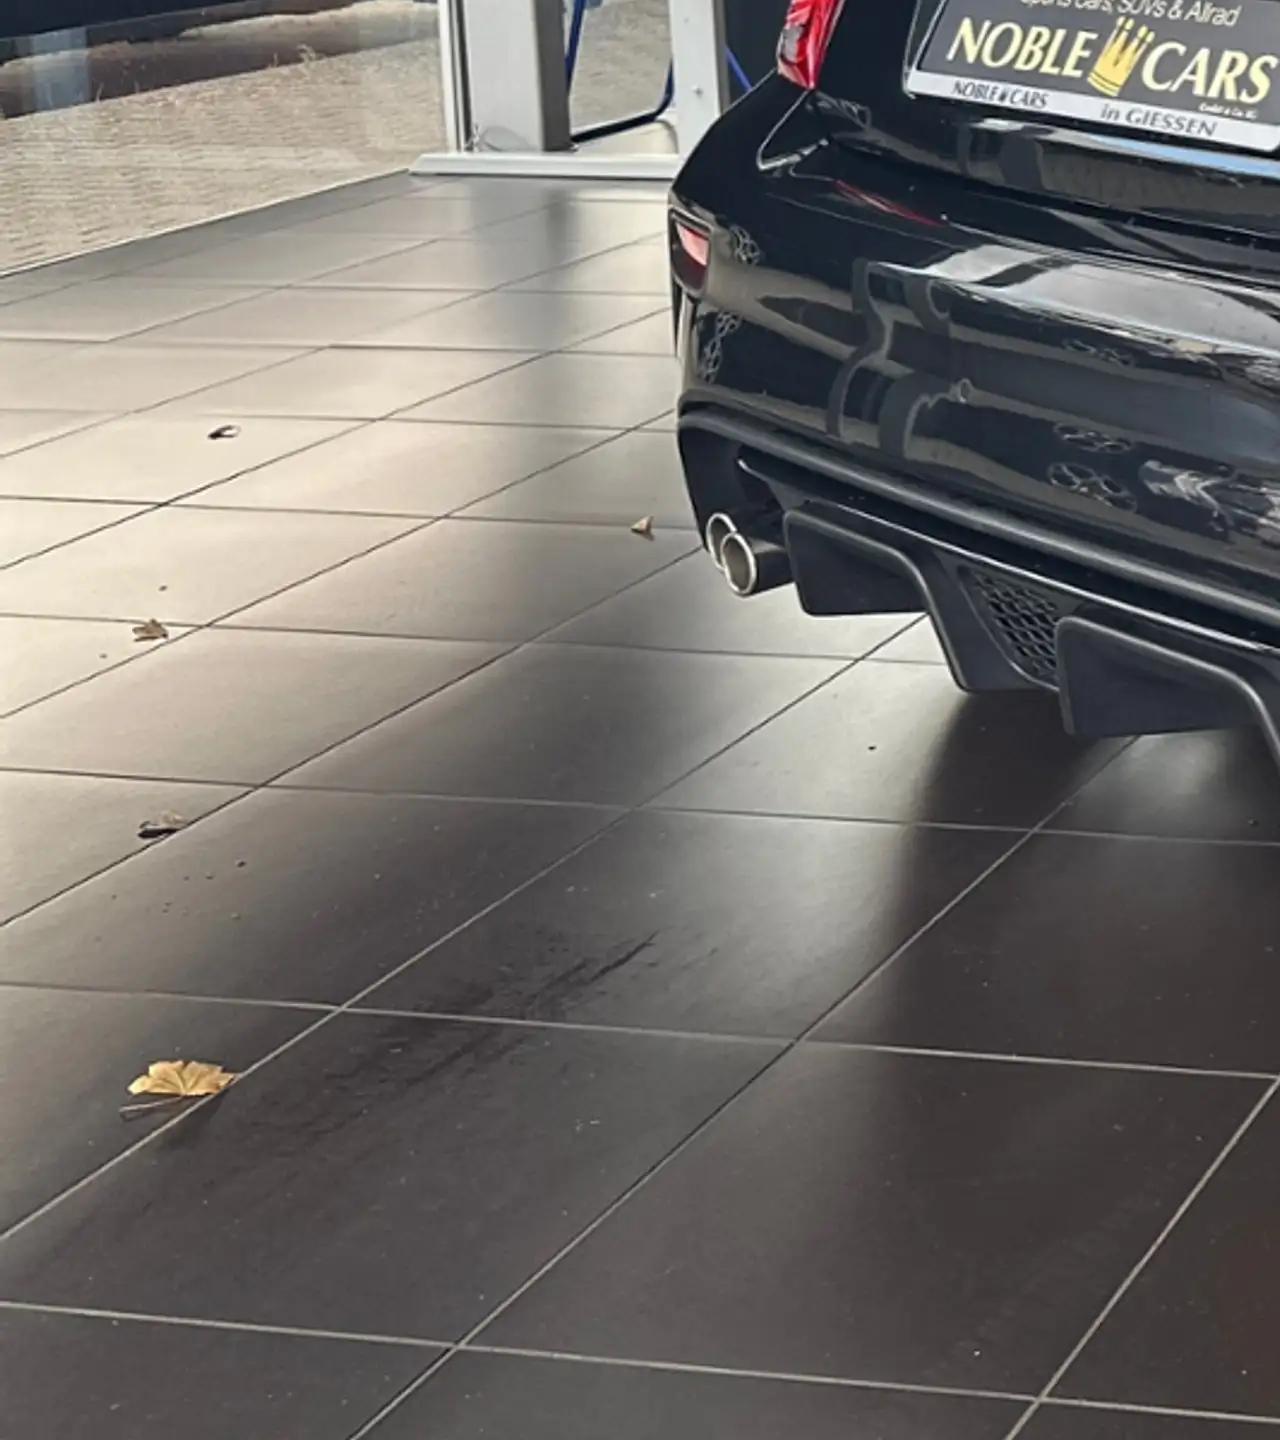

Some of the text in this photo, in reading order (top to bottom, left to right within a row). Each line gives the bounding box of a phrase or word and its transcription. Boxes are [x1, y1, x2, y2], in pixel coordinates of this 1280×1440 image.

[1184, 0, 1242, 27] Allrad
[946, 16, 1280, 104] NOBLE CARS
[952, 81, 998, 101] NOBLE
[1010, 88, 1051, 110] CARS
[1100, 103, 1120, 121] in
[1125, 109, 1219, 137] GIESSEN
